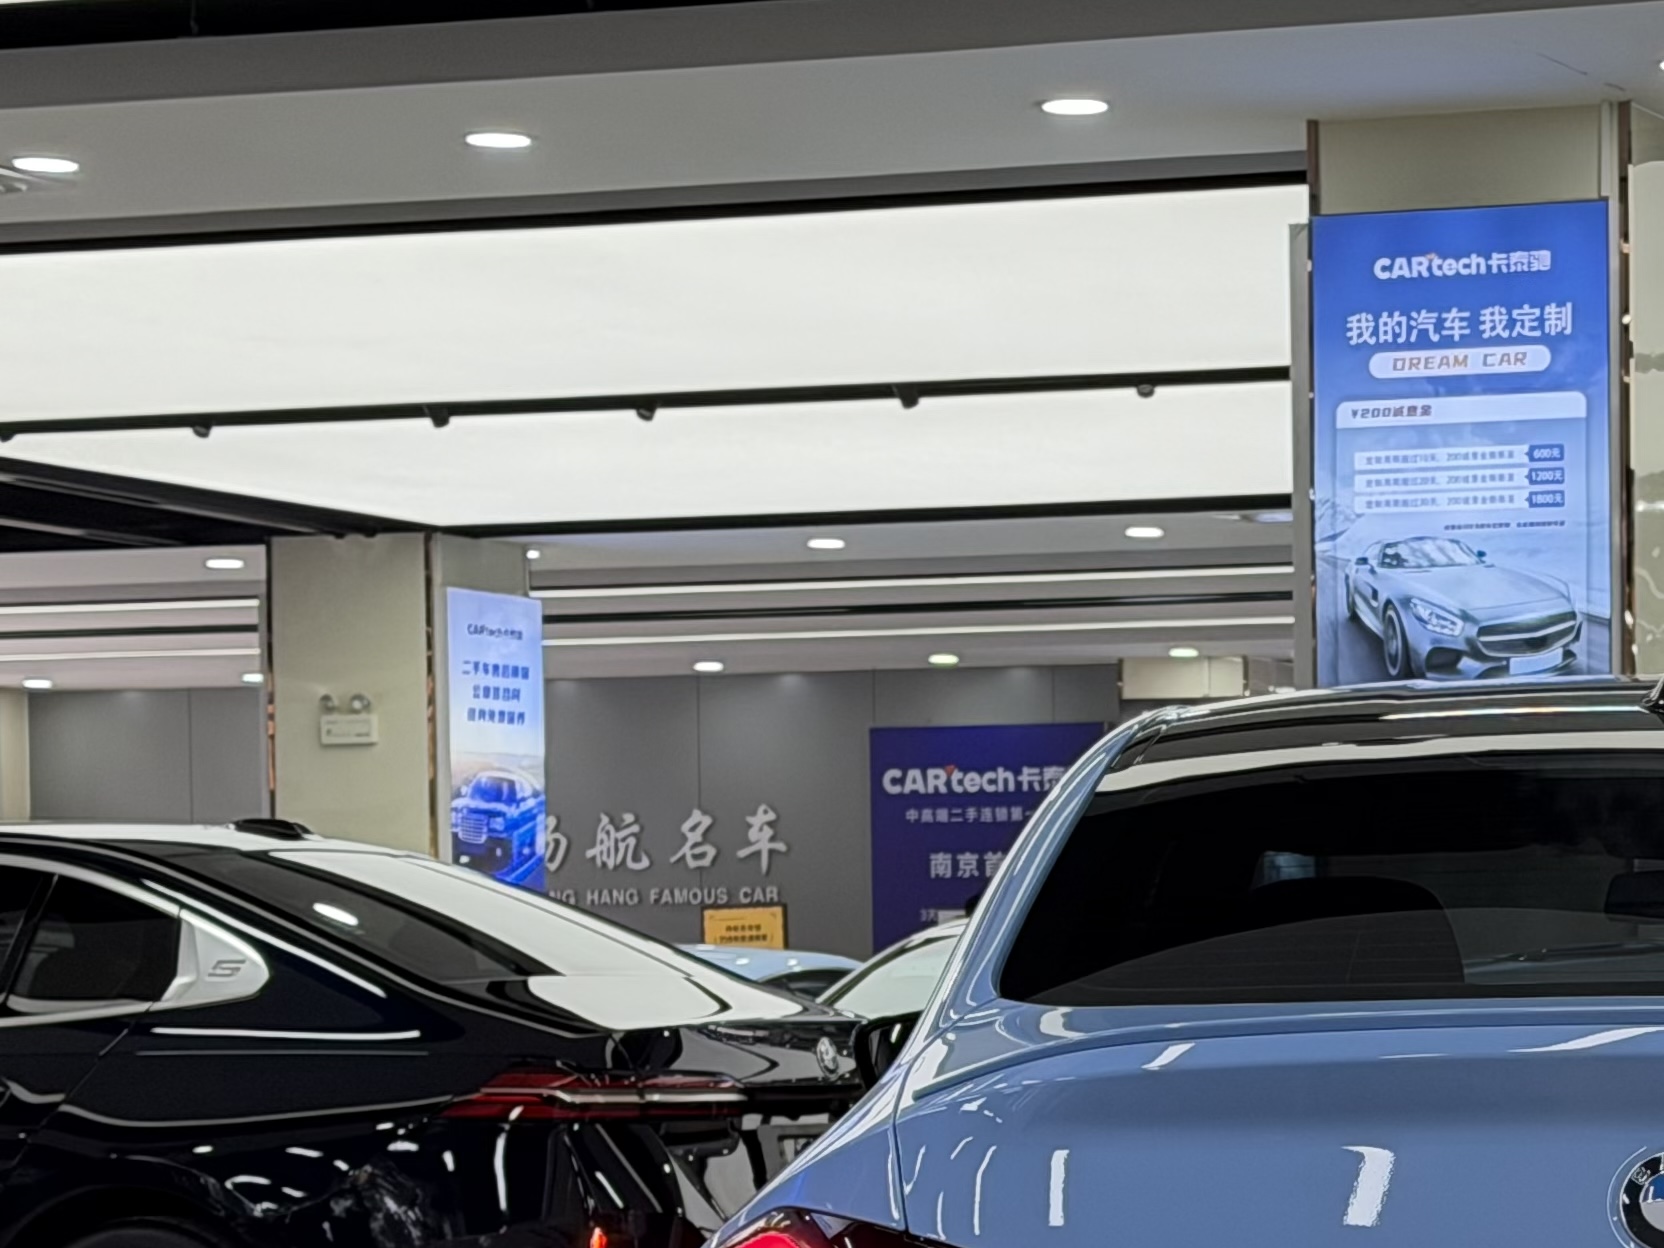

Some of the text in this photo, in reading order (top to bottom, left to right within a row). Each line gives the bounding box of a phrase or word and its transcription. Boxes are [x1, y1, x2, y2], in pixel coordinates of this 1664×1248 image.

[1373, 249, 1551, 280] CARtech 卡泰驰
[1345, 301, 1573, 346] 我的汽车 我定制
[1392, 351, 1528, 372] DREAM CAR
[882, 765, 1070, 794] CARtech 卡泰
[587, 888, 640, 906] HANG
[650, 887, 728, 905] FAMOUS
[740, 886, 778, 903] CAR
